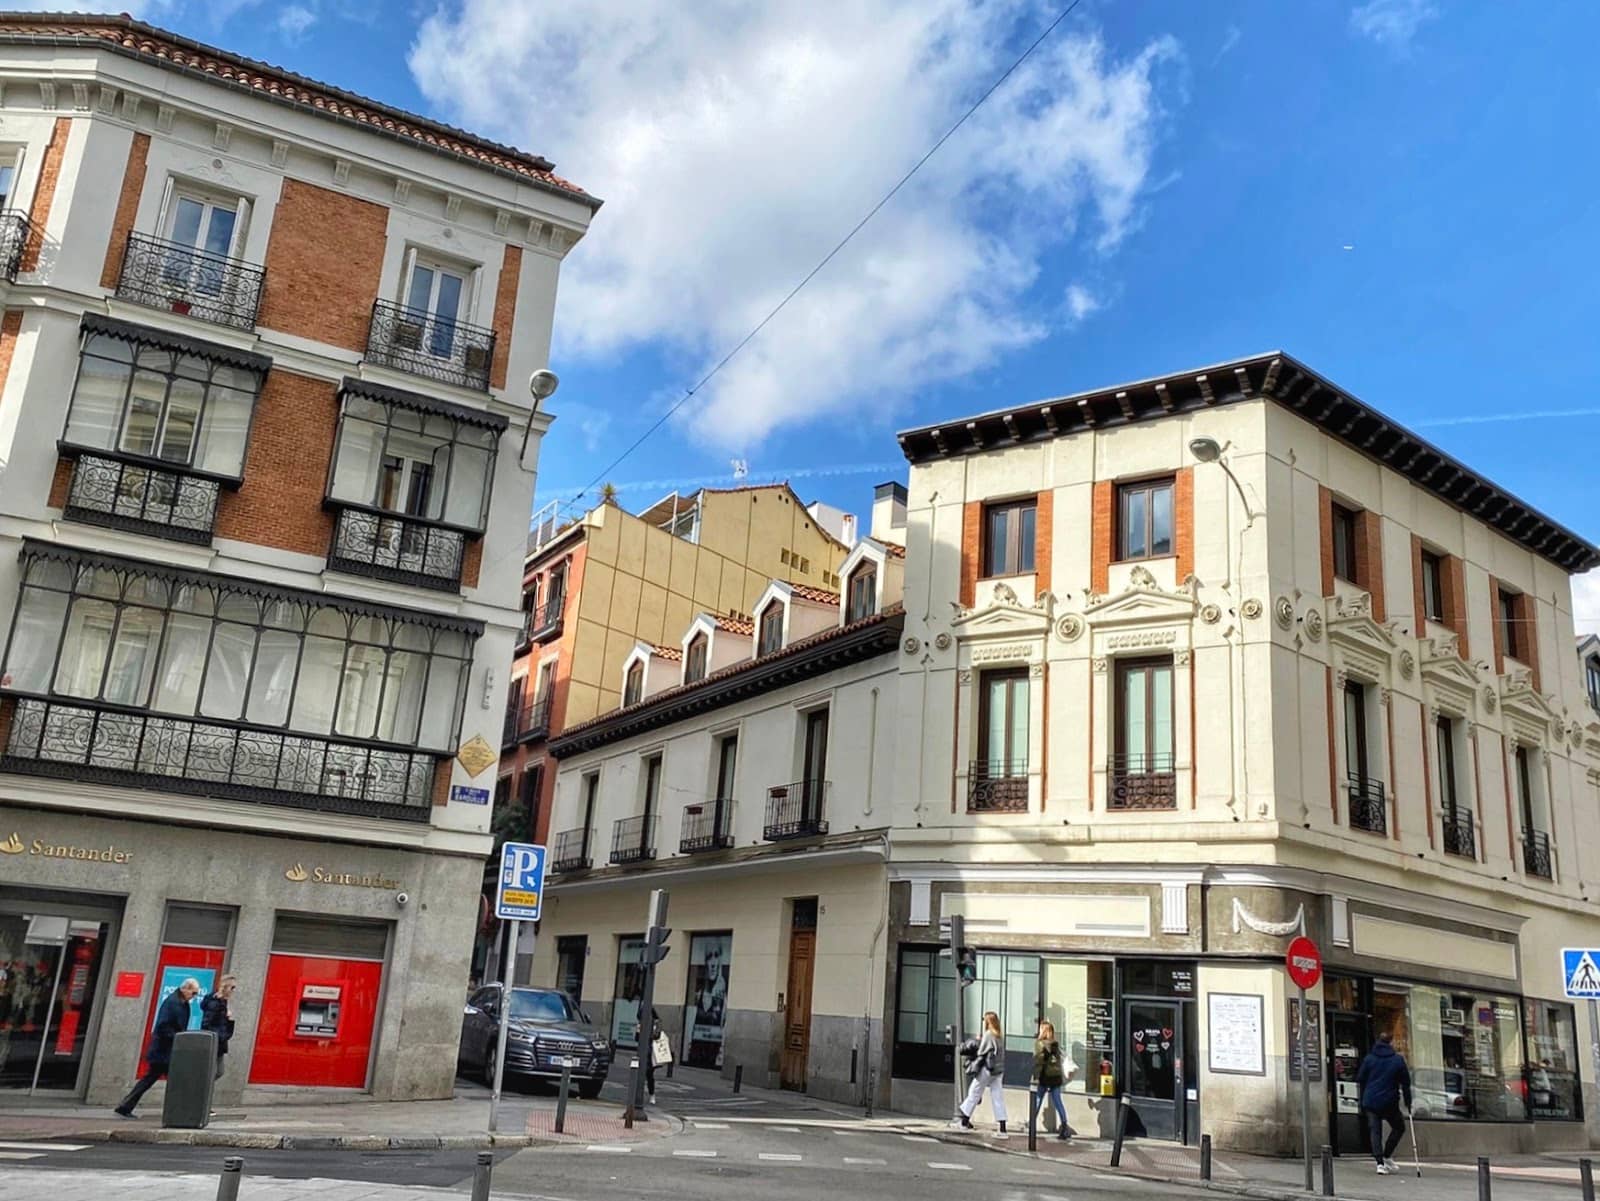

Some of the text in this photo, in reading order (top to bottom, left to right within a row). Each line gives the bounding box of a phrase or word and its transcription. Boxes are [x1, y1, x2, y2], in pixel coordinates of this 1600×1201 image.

[30, 839, 133, 864] Santander
[312, 866, 400, 889] Santander
[508, 848, 538, 888] P
